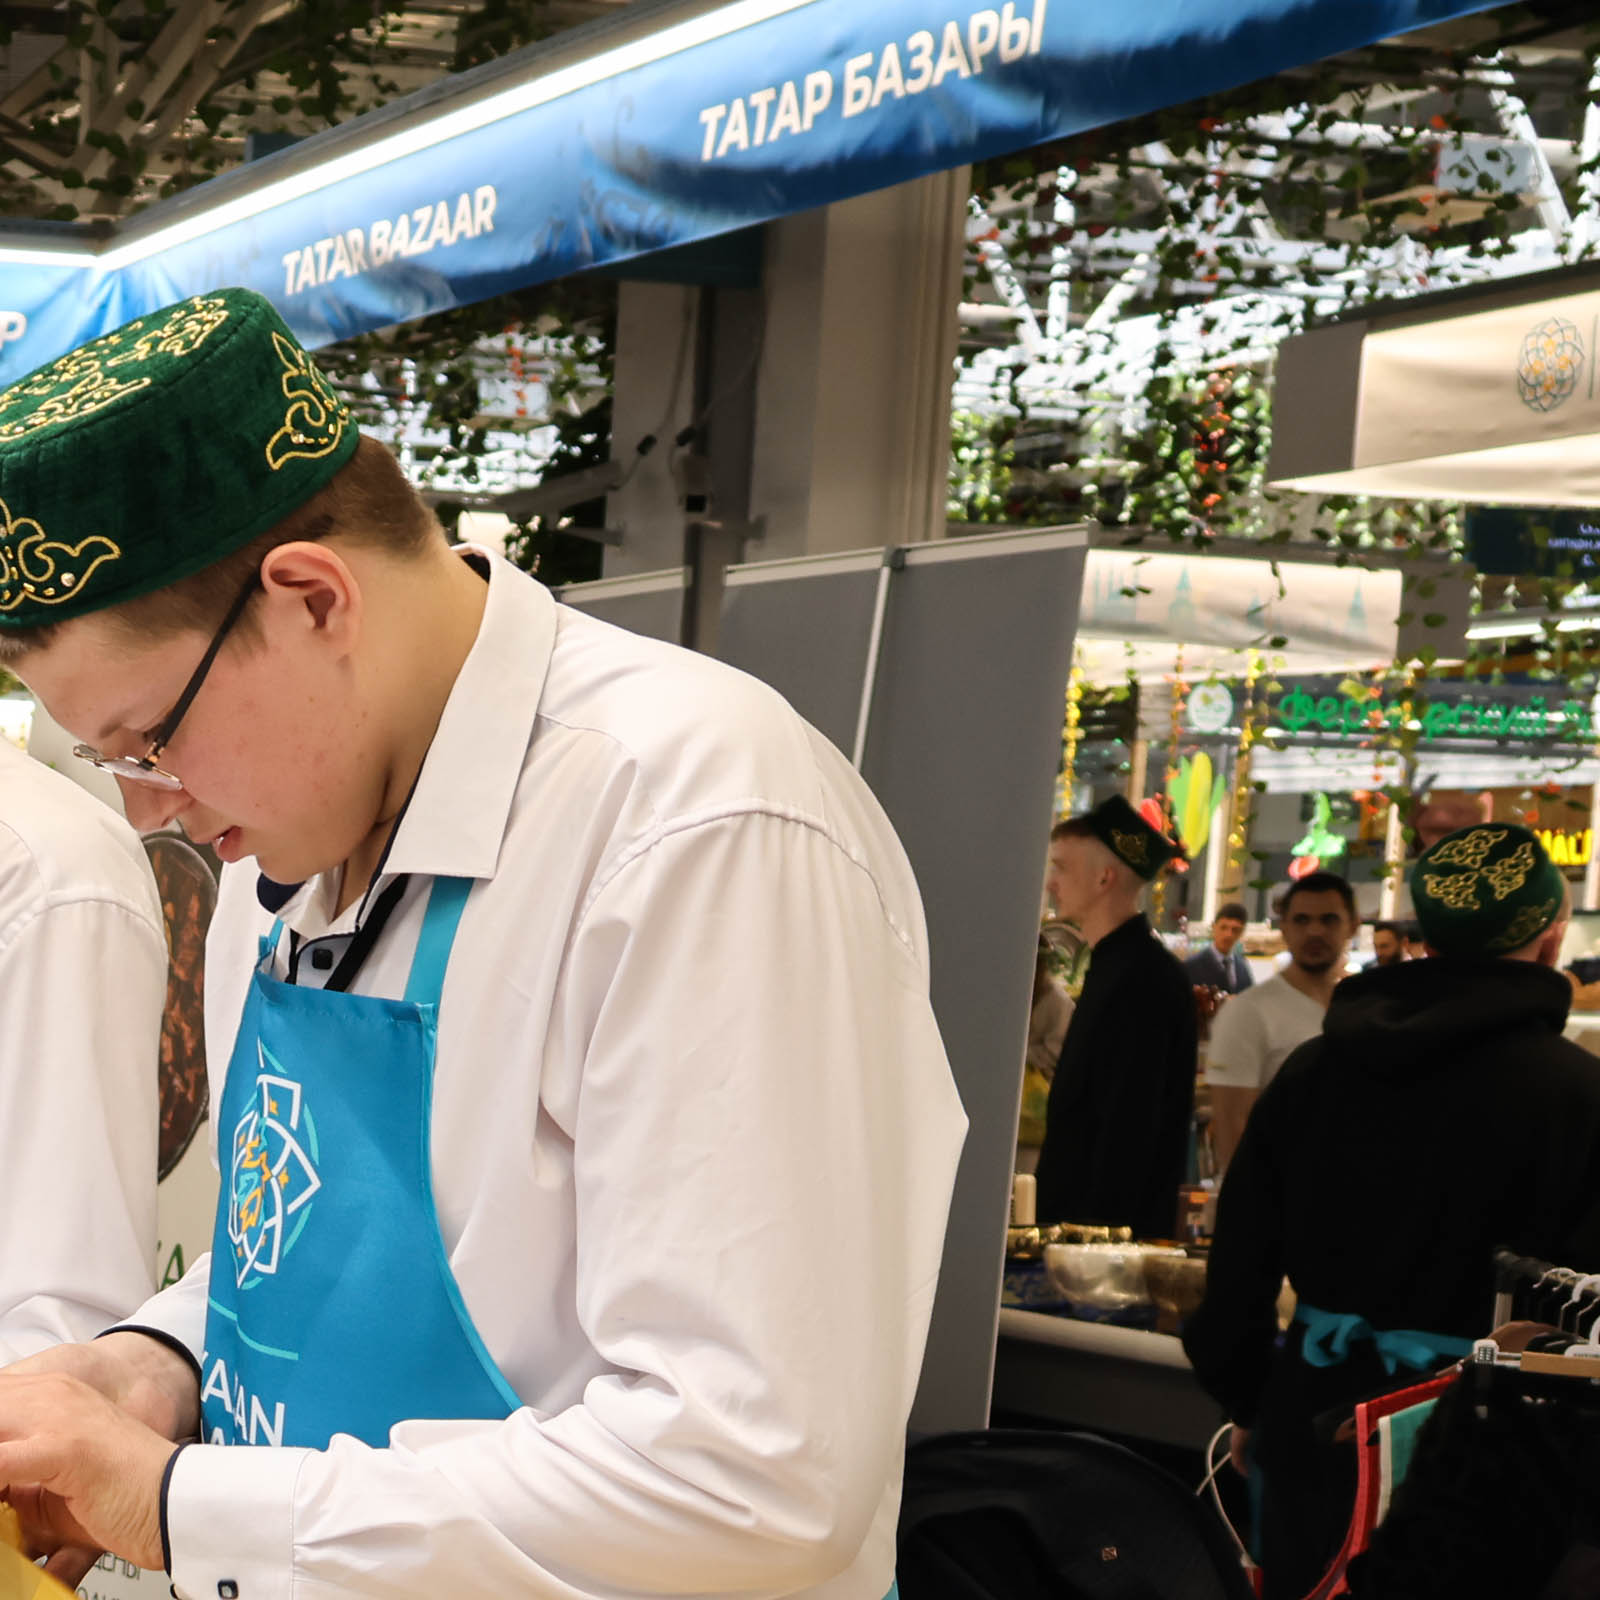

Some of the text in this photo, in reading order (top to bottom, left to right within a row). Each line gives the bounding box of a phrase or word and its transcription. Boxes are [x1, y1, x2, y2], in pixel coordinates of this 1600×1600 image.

[699, 0, 1047, 162] ТАТАР БАЗАРЫ
[282, 184, 498, 296] TATAR BAZAAR
